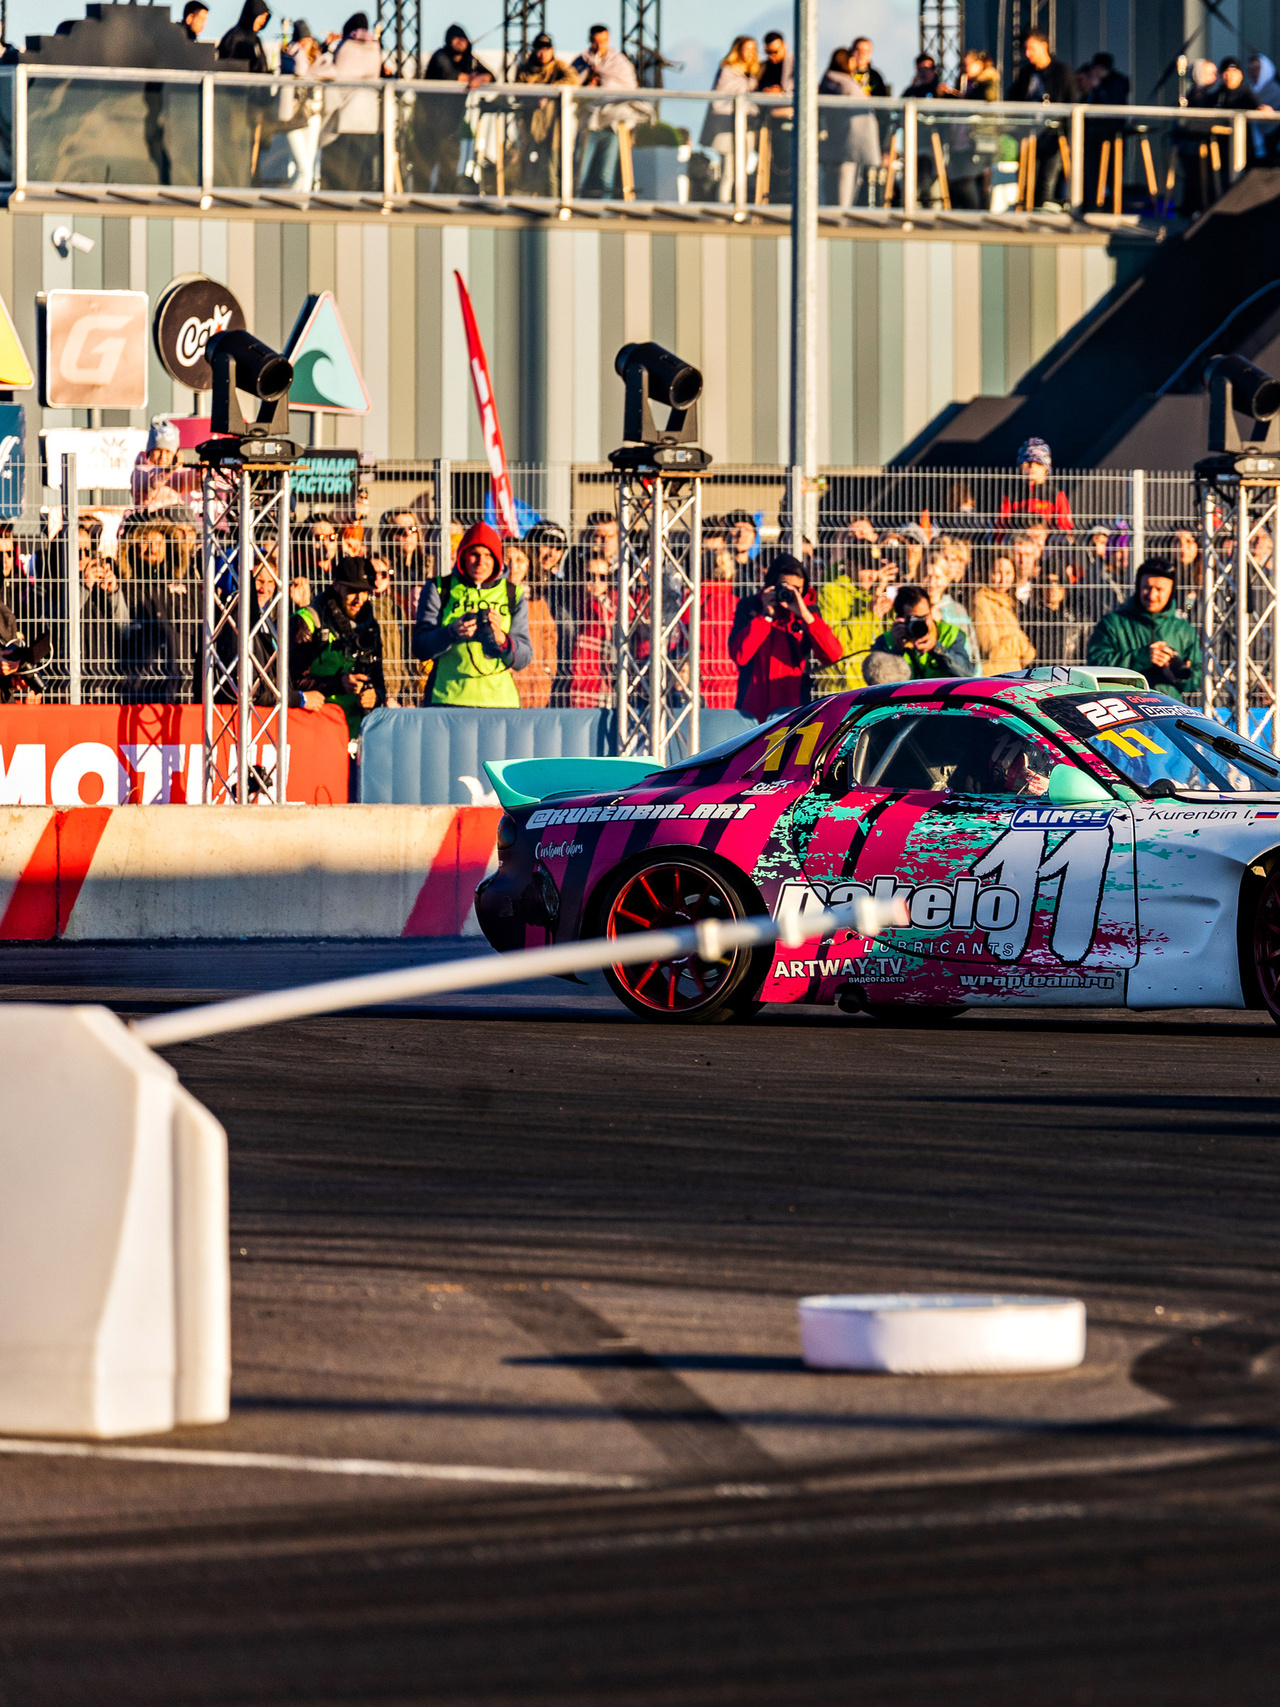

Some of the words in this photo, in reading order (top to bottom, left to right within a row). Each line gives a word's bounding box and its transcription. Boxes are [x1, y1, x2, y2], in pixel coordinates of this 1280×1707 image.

[60, 314, 134, 385] G
[1076, 697, 1139, 729] 22
[763, 721, 824, 771] 11
[1096, 727, 1168, 757] 11
[1015, 808, 1108, 825] AIMOL
[1149, 809, 1237, 820] Kurenbin
[968, 823, 1116, 965] 11
[863, 939, 1014, 956] LUBRICANTS
[773, 957, 904, 978] ARTWAY.TV
[848, 975, 905, 984] видеогазета
[959, 972, 1115, 989] wrapteam.ru
